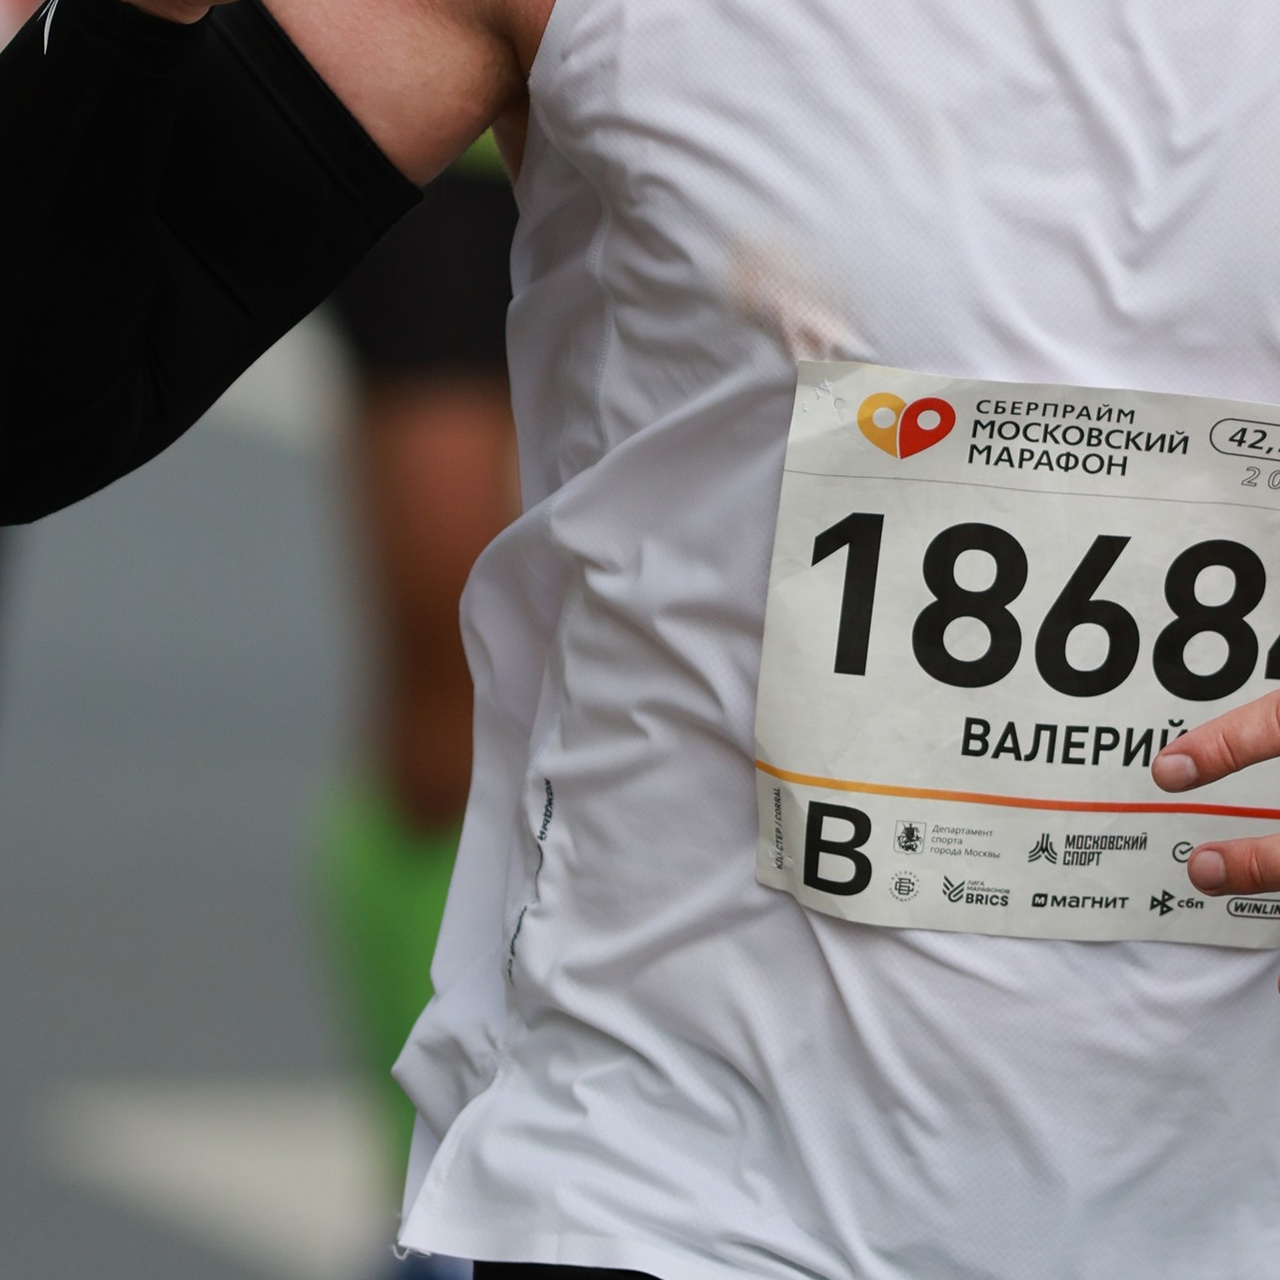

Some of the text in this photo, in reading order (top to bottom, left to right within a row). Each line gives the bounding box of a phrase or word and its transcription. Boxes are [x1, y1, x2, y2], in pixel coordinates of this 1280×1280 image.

[976, 399, 1135, 424] СБЕРПРАЙМ
[971, 419, 1189, 455] МОСКОВСКИЙ
[968, 443, 1128, 476] МАРАФОН
[931, 824, 994, 837] Департамент
[931, 836, 963, 846] спорта
[1064, 832, 1148, 851] МОСКОВСКИЙ
[930, 846, 1001, 858] города Москвы
[1063, 850, 1102, 866] СПОРТ
[965, 893, 1009, 907] BRICS
[1178, 898, 1204, 910] сбп
